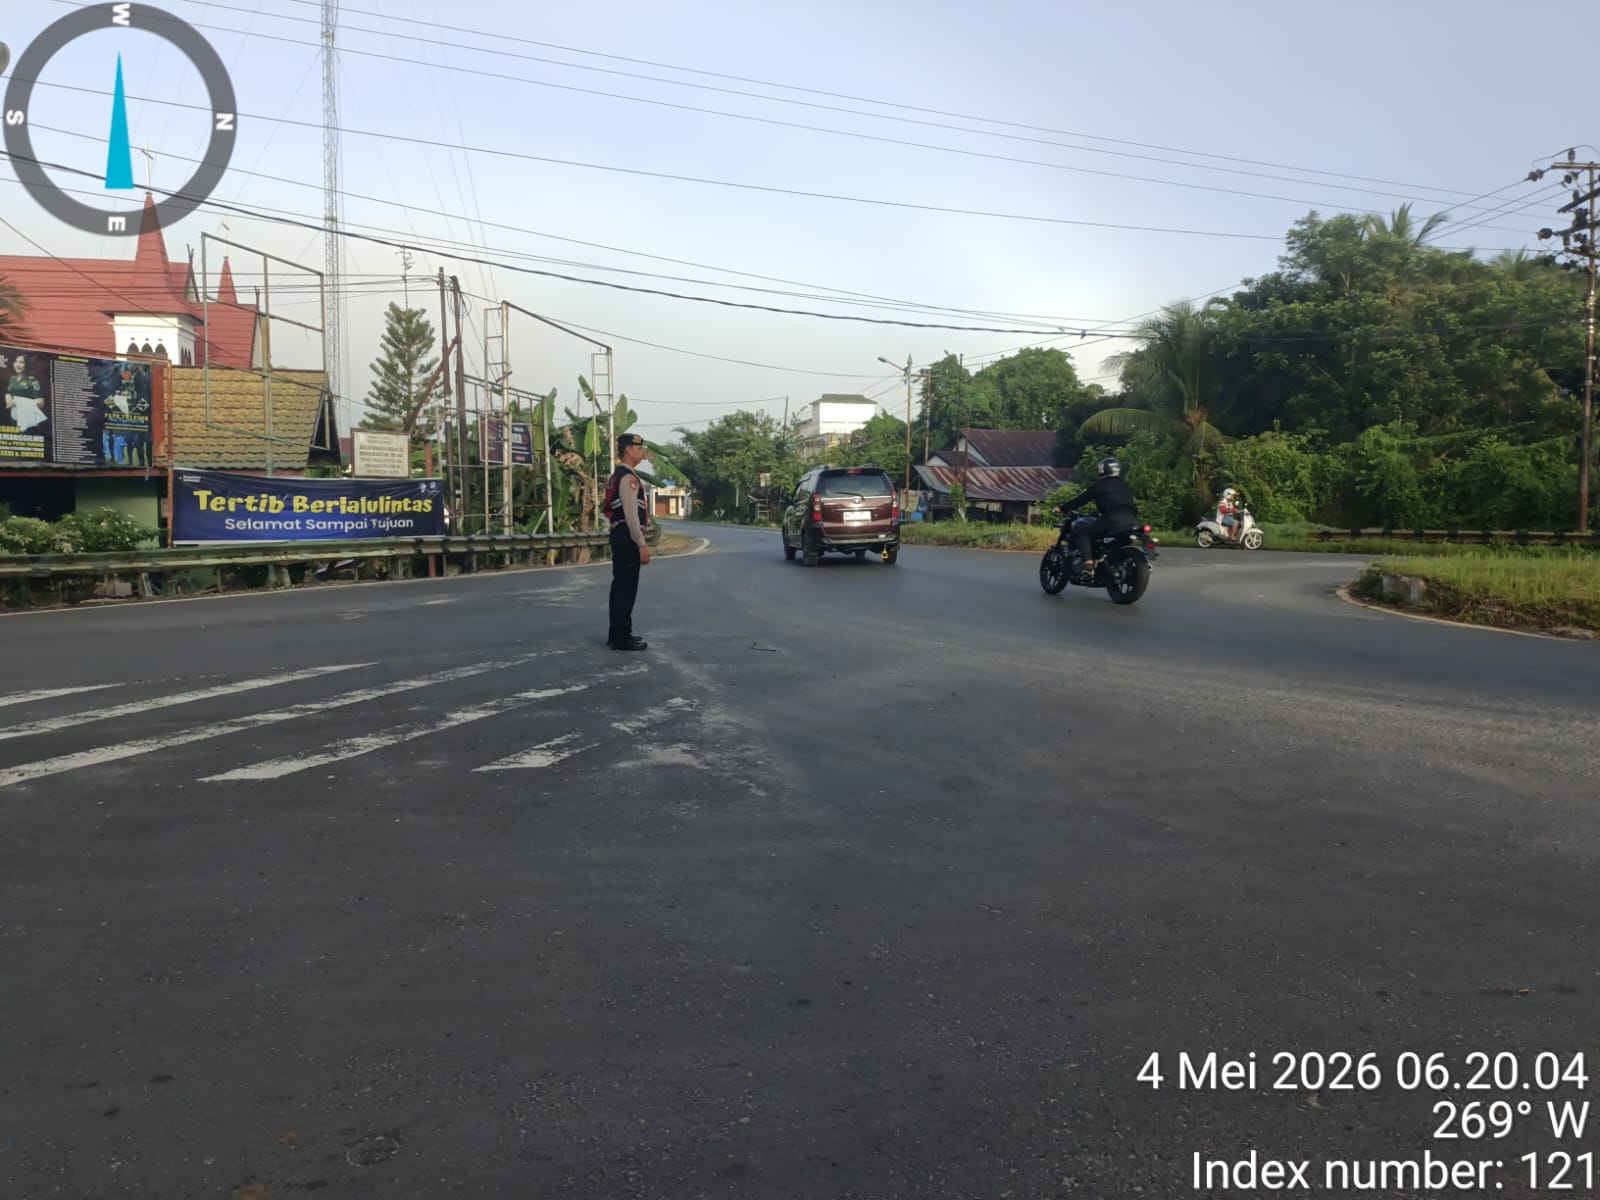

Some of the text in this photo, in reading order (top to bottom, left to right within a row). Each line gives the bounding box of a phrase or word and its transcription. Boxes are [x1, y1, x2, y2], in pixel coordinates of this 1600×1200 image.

[193, 490, 433, 514] Tertib Berlalulintas
[225, 518, 414, 533] Selamat Sampai Tujuan
